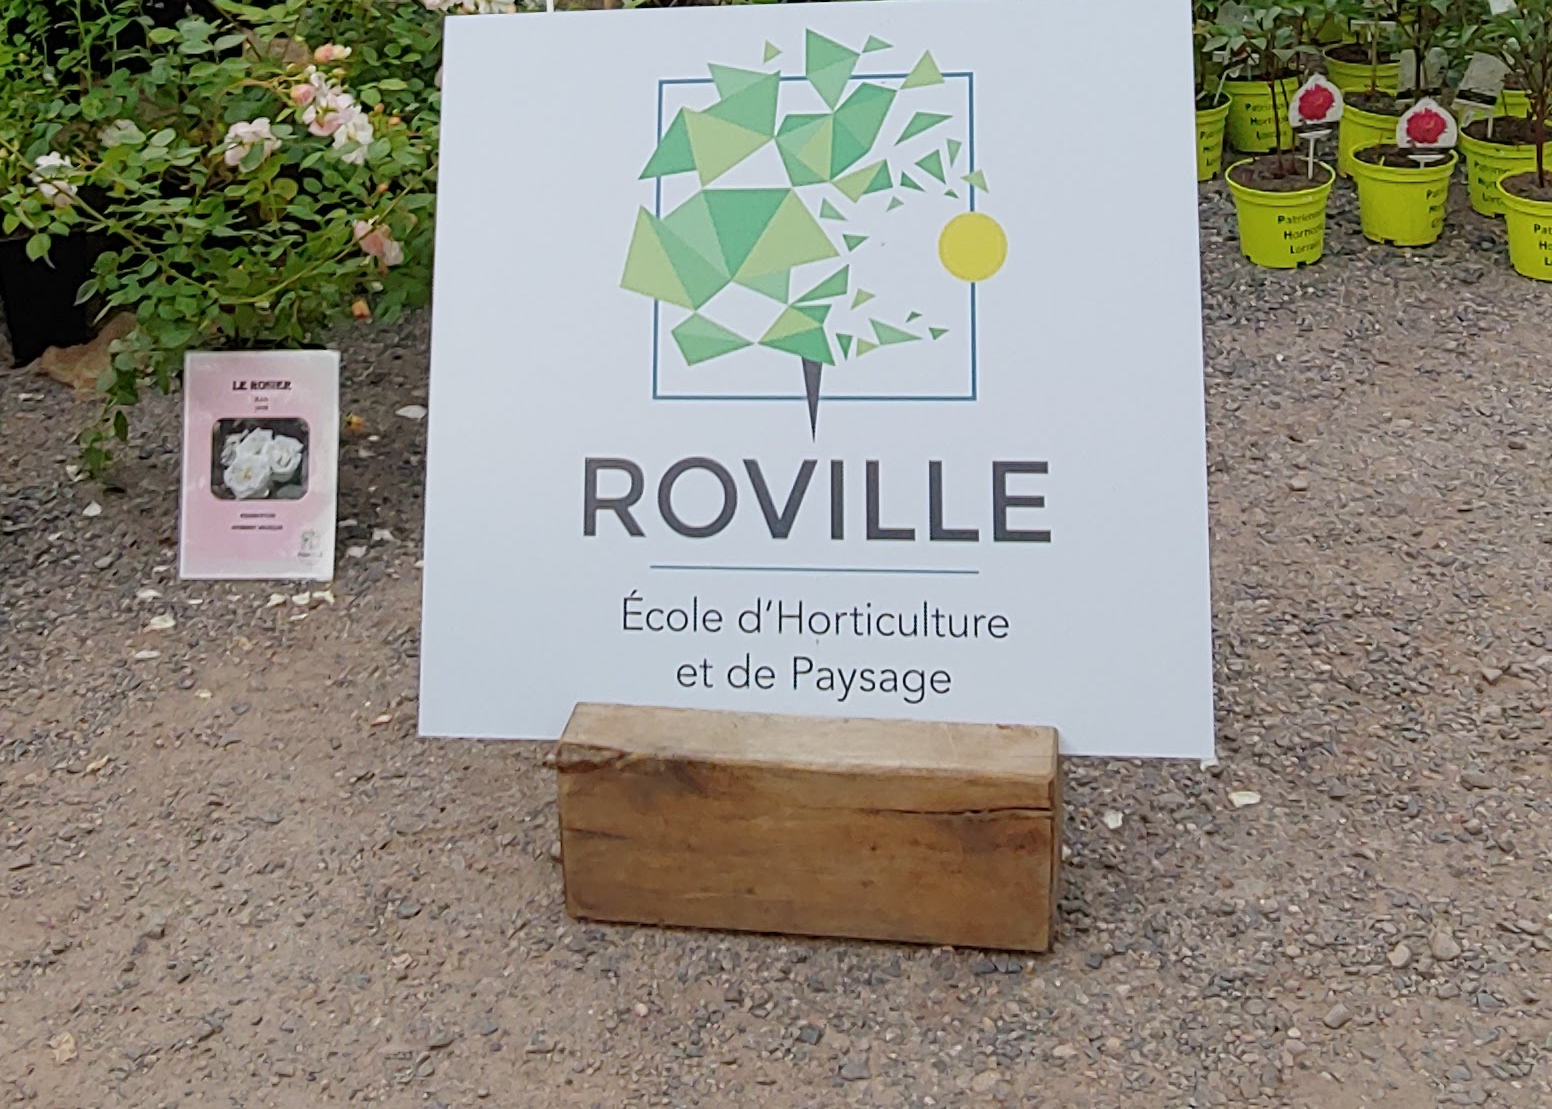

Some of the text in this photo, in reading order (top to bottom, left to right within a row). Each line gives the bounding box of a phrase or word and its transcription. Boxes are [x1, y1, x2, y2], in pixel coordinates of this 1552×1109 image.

[232, 380, 292, 391] LE ROSIER
[583, 456, 1052, 542] ROVILLE
[623, 589, 1010, 639] École d'Horticulture
[676, 652, 952, 704] et de Paysage
